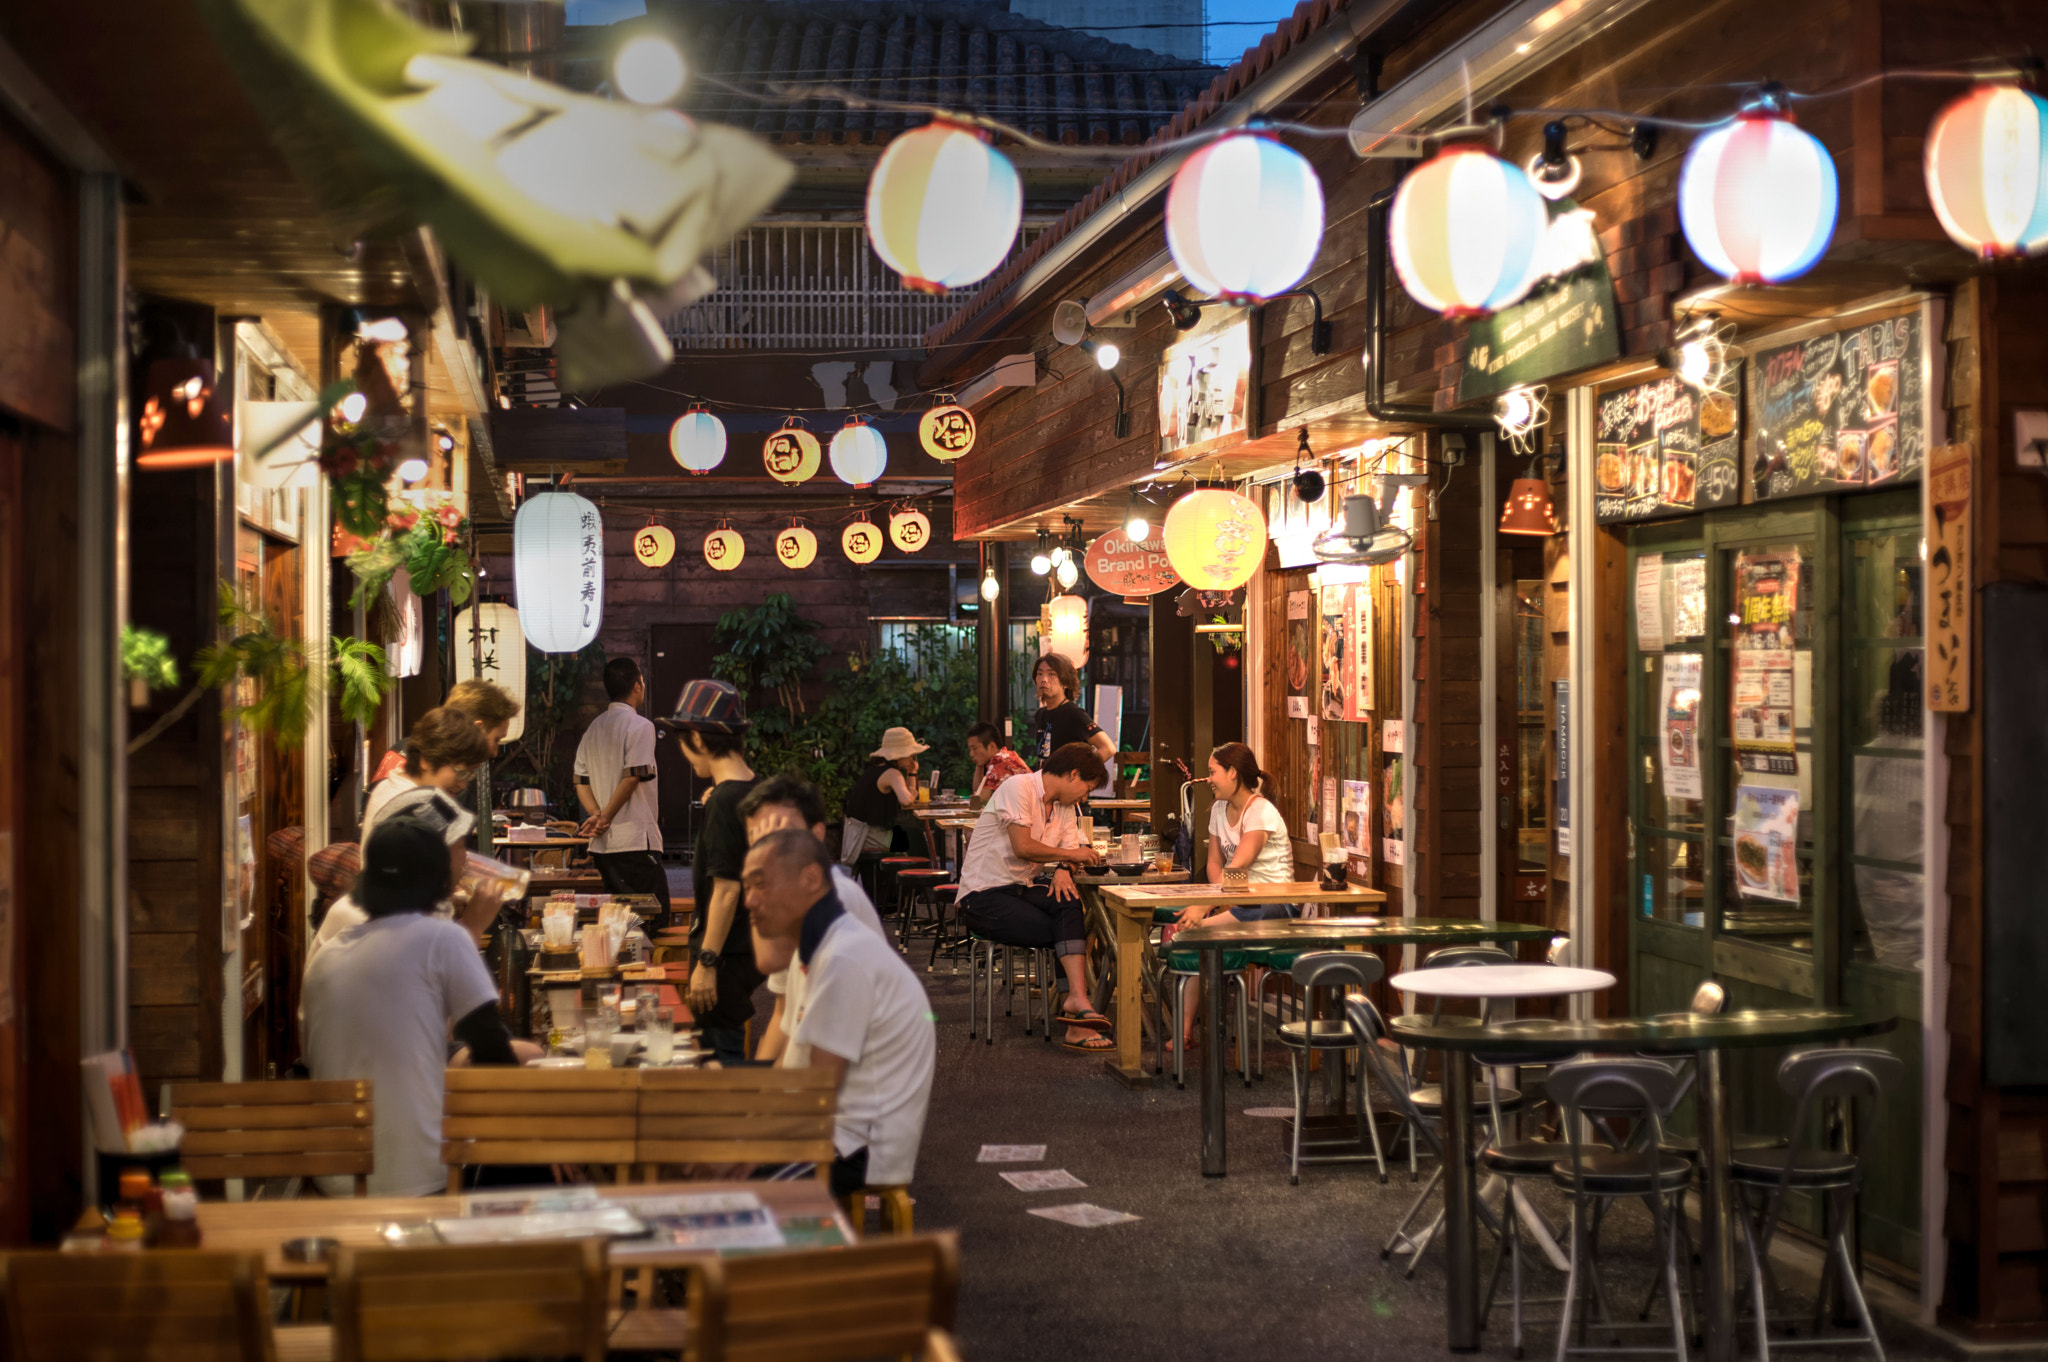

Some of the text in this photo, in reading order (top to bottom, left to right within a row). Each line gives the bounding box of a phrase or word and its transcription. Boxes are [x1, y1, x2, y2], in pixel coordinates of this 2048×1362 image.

[1842, 318, 1909, 378] TAPAS
[936, 415, 964, 438] ya
[1653, 393, 1694, 437] pizza
[943, 424, 972, 448] tai
[766, 437, 790, 461] ya
[771, 447, 800, 472] tai
[580, 511, 597, 628] 蝦夷前寿し
[1097, 557, 1146, 574] Brand
[1500, 745, 1510, 785] 出入口
